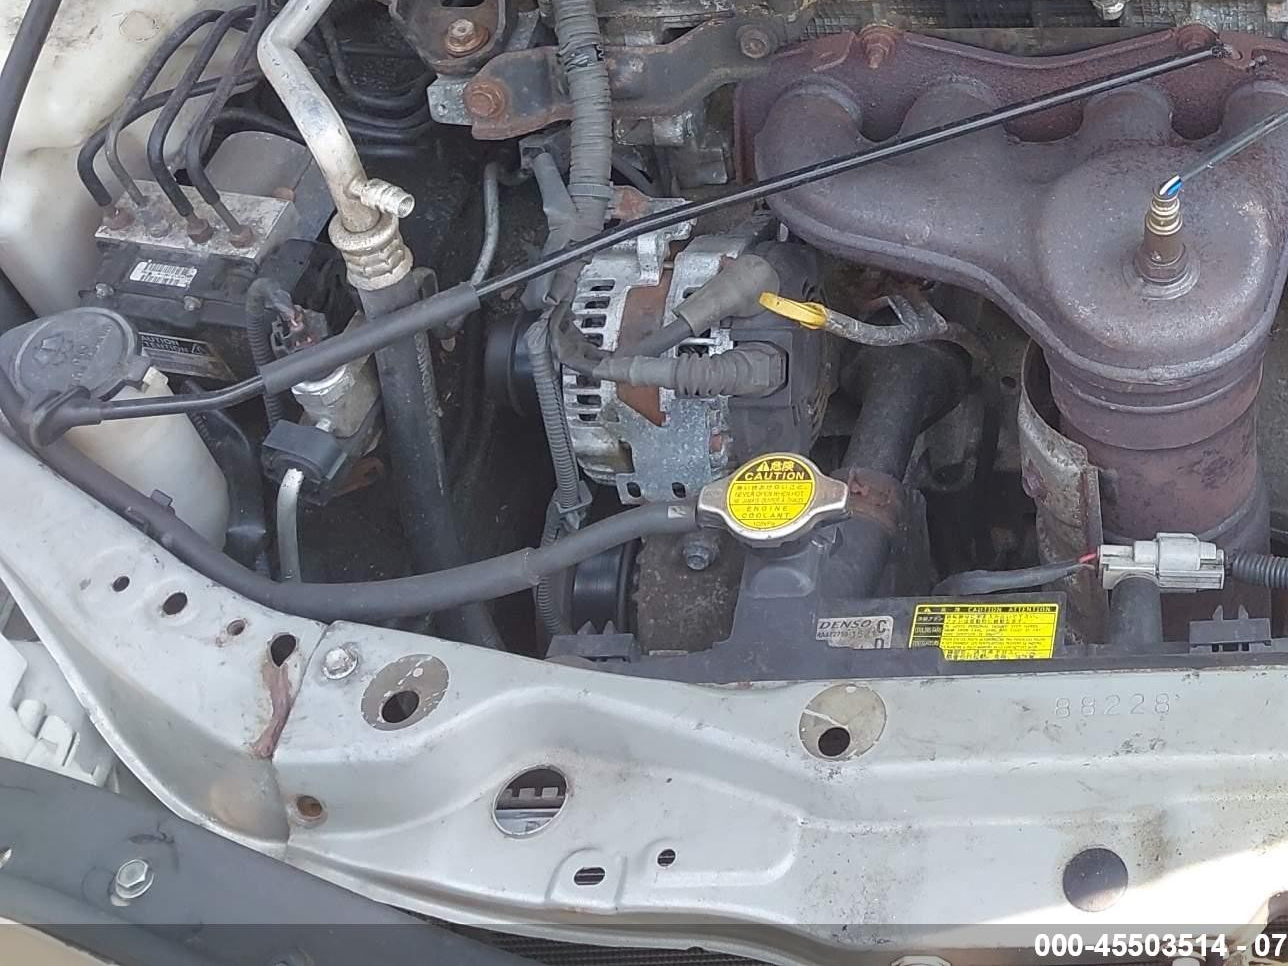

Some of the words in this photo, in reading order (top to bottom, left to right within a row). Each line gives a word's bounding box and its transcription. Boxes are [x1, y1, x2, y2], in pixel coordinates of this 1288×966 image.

[142, 335, 180, 346] AUTION
[744, 471, 805, 480] CAUTION
[741, 512, 791, 520] COOLANT
[818, 619, 872, 630] DENSO
[1055, 693, 1170, 718] 88228
